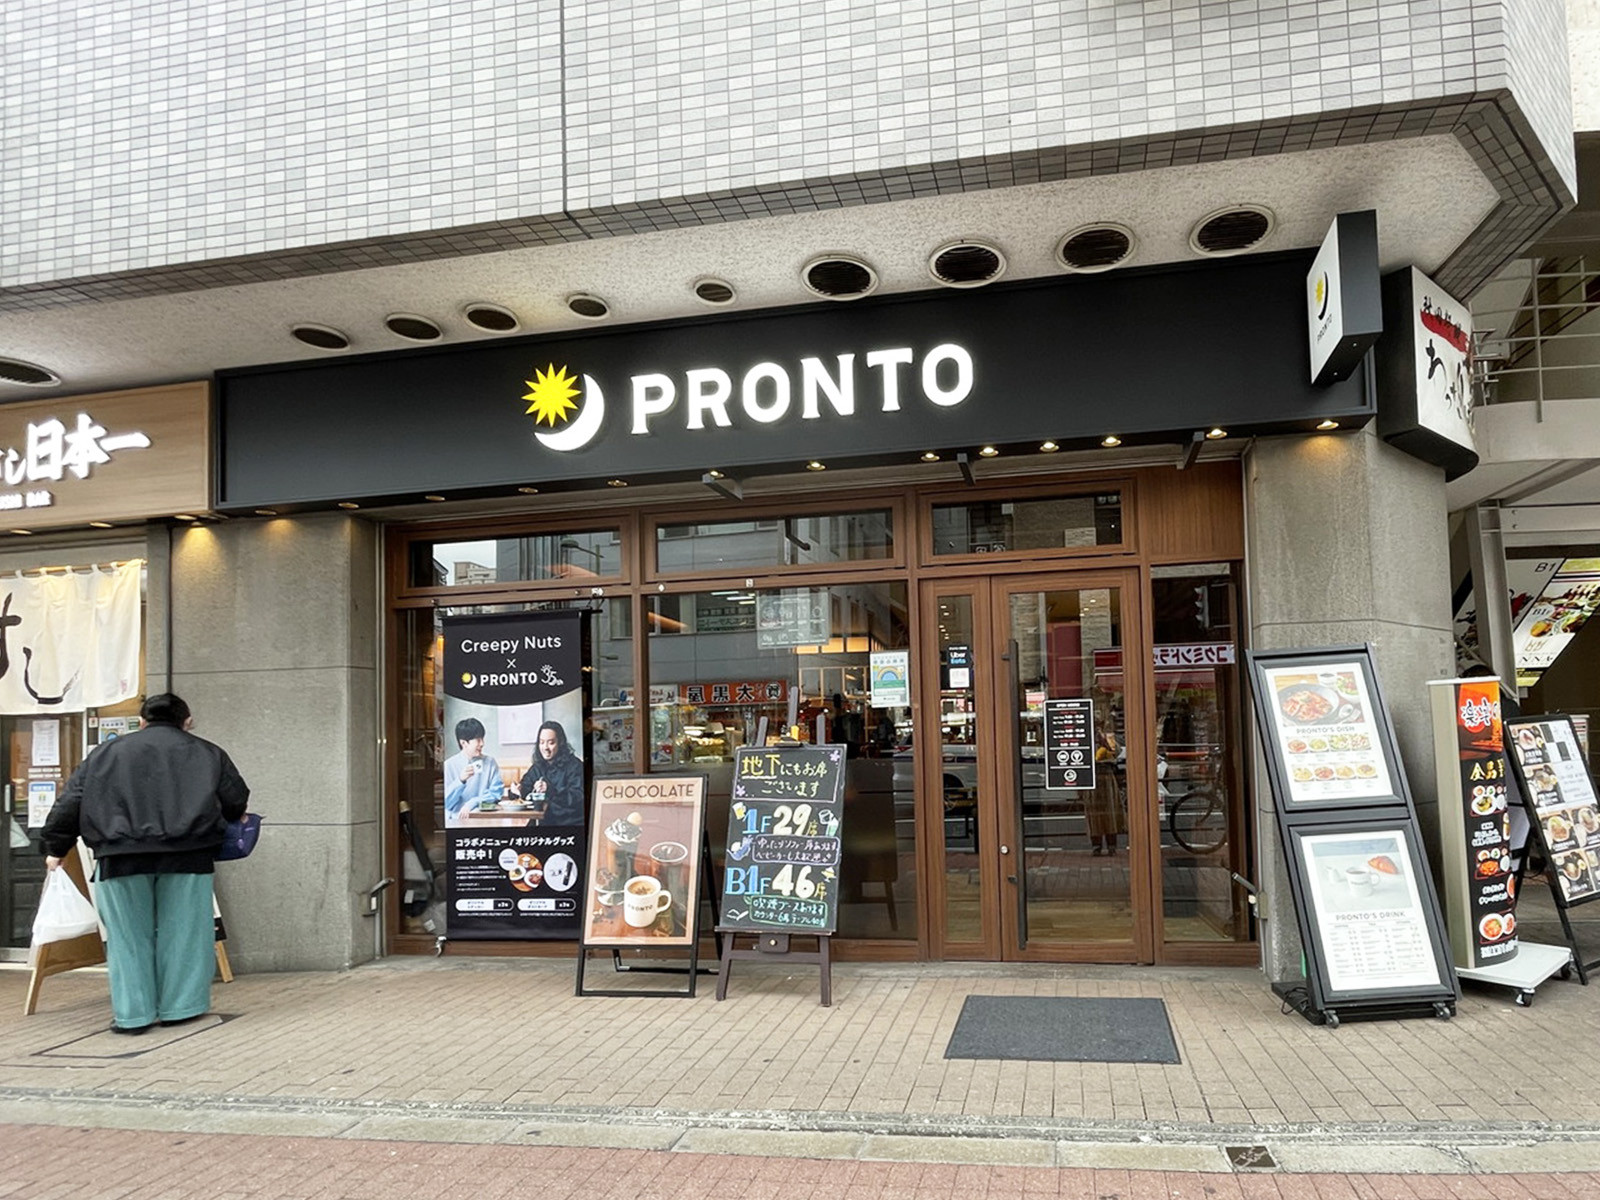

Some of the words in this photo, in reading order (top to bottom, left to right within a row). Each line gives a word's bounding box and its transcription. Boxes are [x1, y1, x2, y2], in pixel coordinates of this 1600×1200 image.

[630, 343, 974, 436] PRONTO
[0, 413, 151, 485] し日本一
[1535, 562, 1556, 573] B1
[461, 639, 519, 654] Creepy
[524, 636, 562, 650] Nuts
[480, 672, 537, 686] PRONTO
[741, 754, 828, 778] 地下にもお席
[602, 784, 695, 799] CHOCOLATE
[761, 780, 821, 798] ございます
[742, 808, 772, 834] 1F
[725, 865, 772, 896] B1F
[1335, 912, 1377, 920] PRONTO'S
